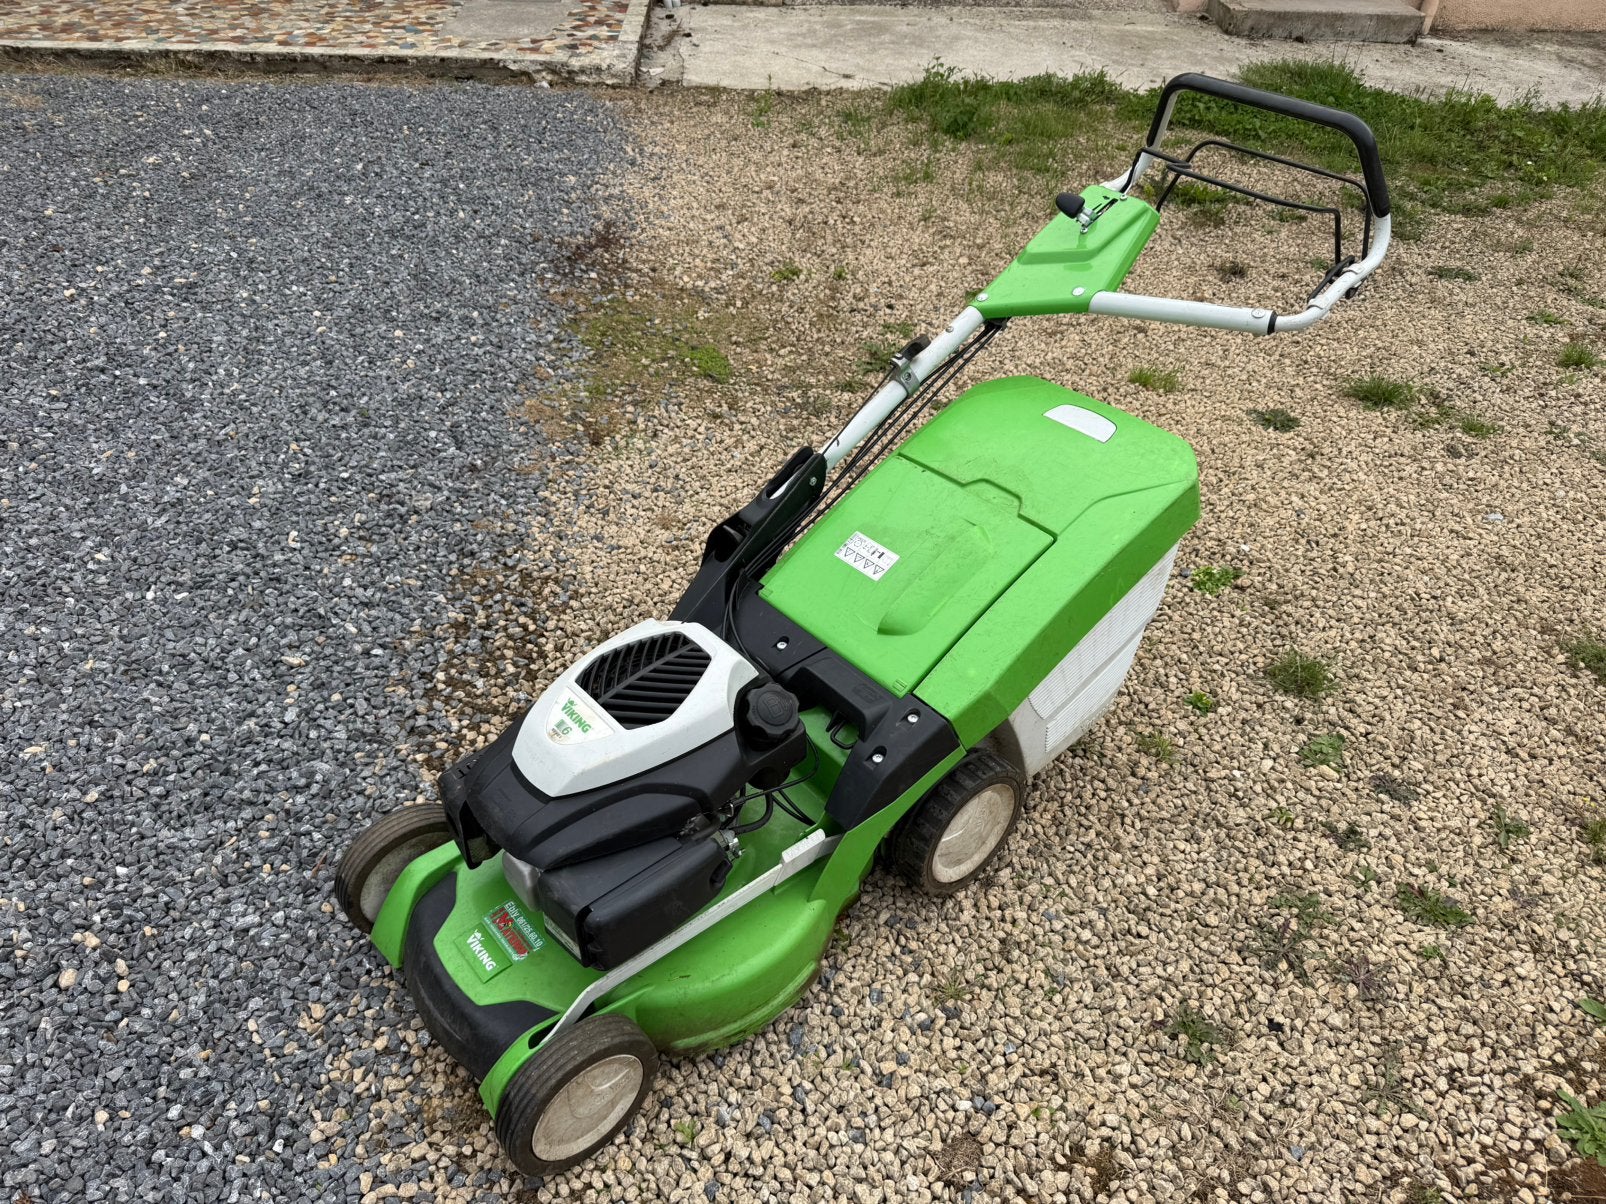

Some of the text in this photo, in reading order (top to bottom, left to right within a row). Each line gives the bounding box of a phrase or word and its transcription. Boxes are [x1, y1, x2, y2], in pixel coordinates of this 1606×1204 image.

[561, 702, 591, 733] VIKING
[504, 901, 520, 921] Ebly
[466, 933, 497, 971] VIKING
